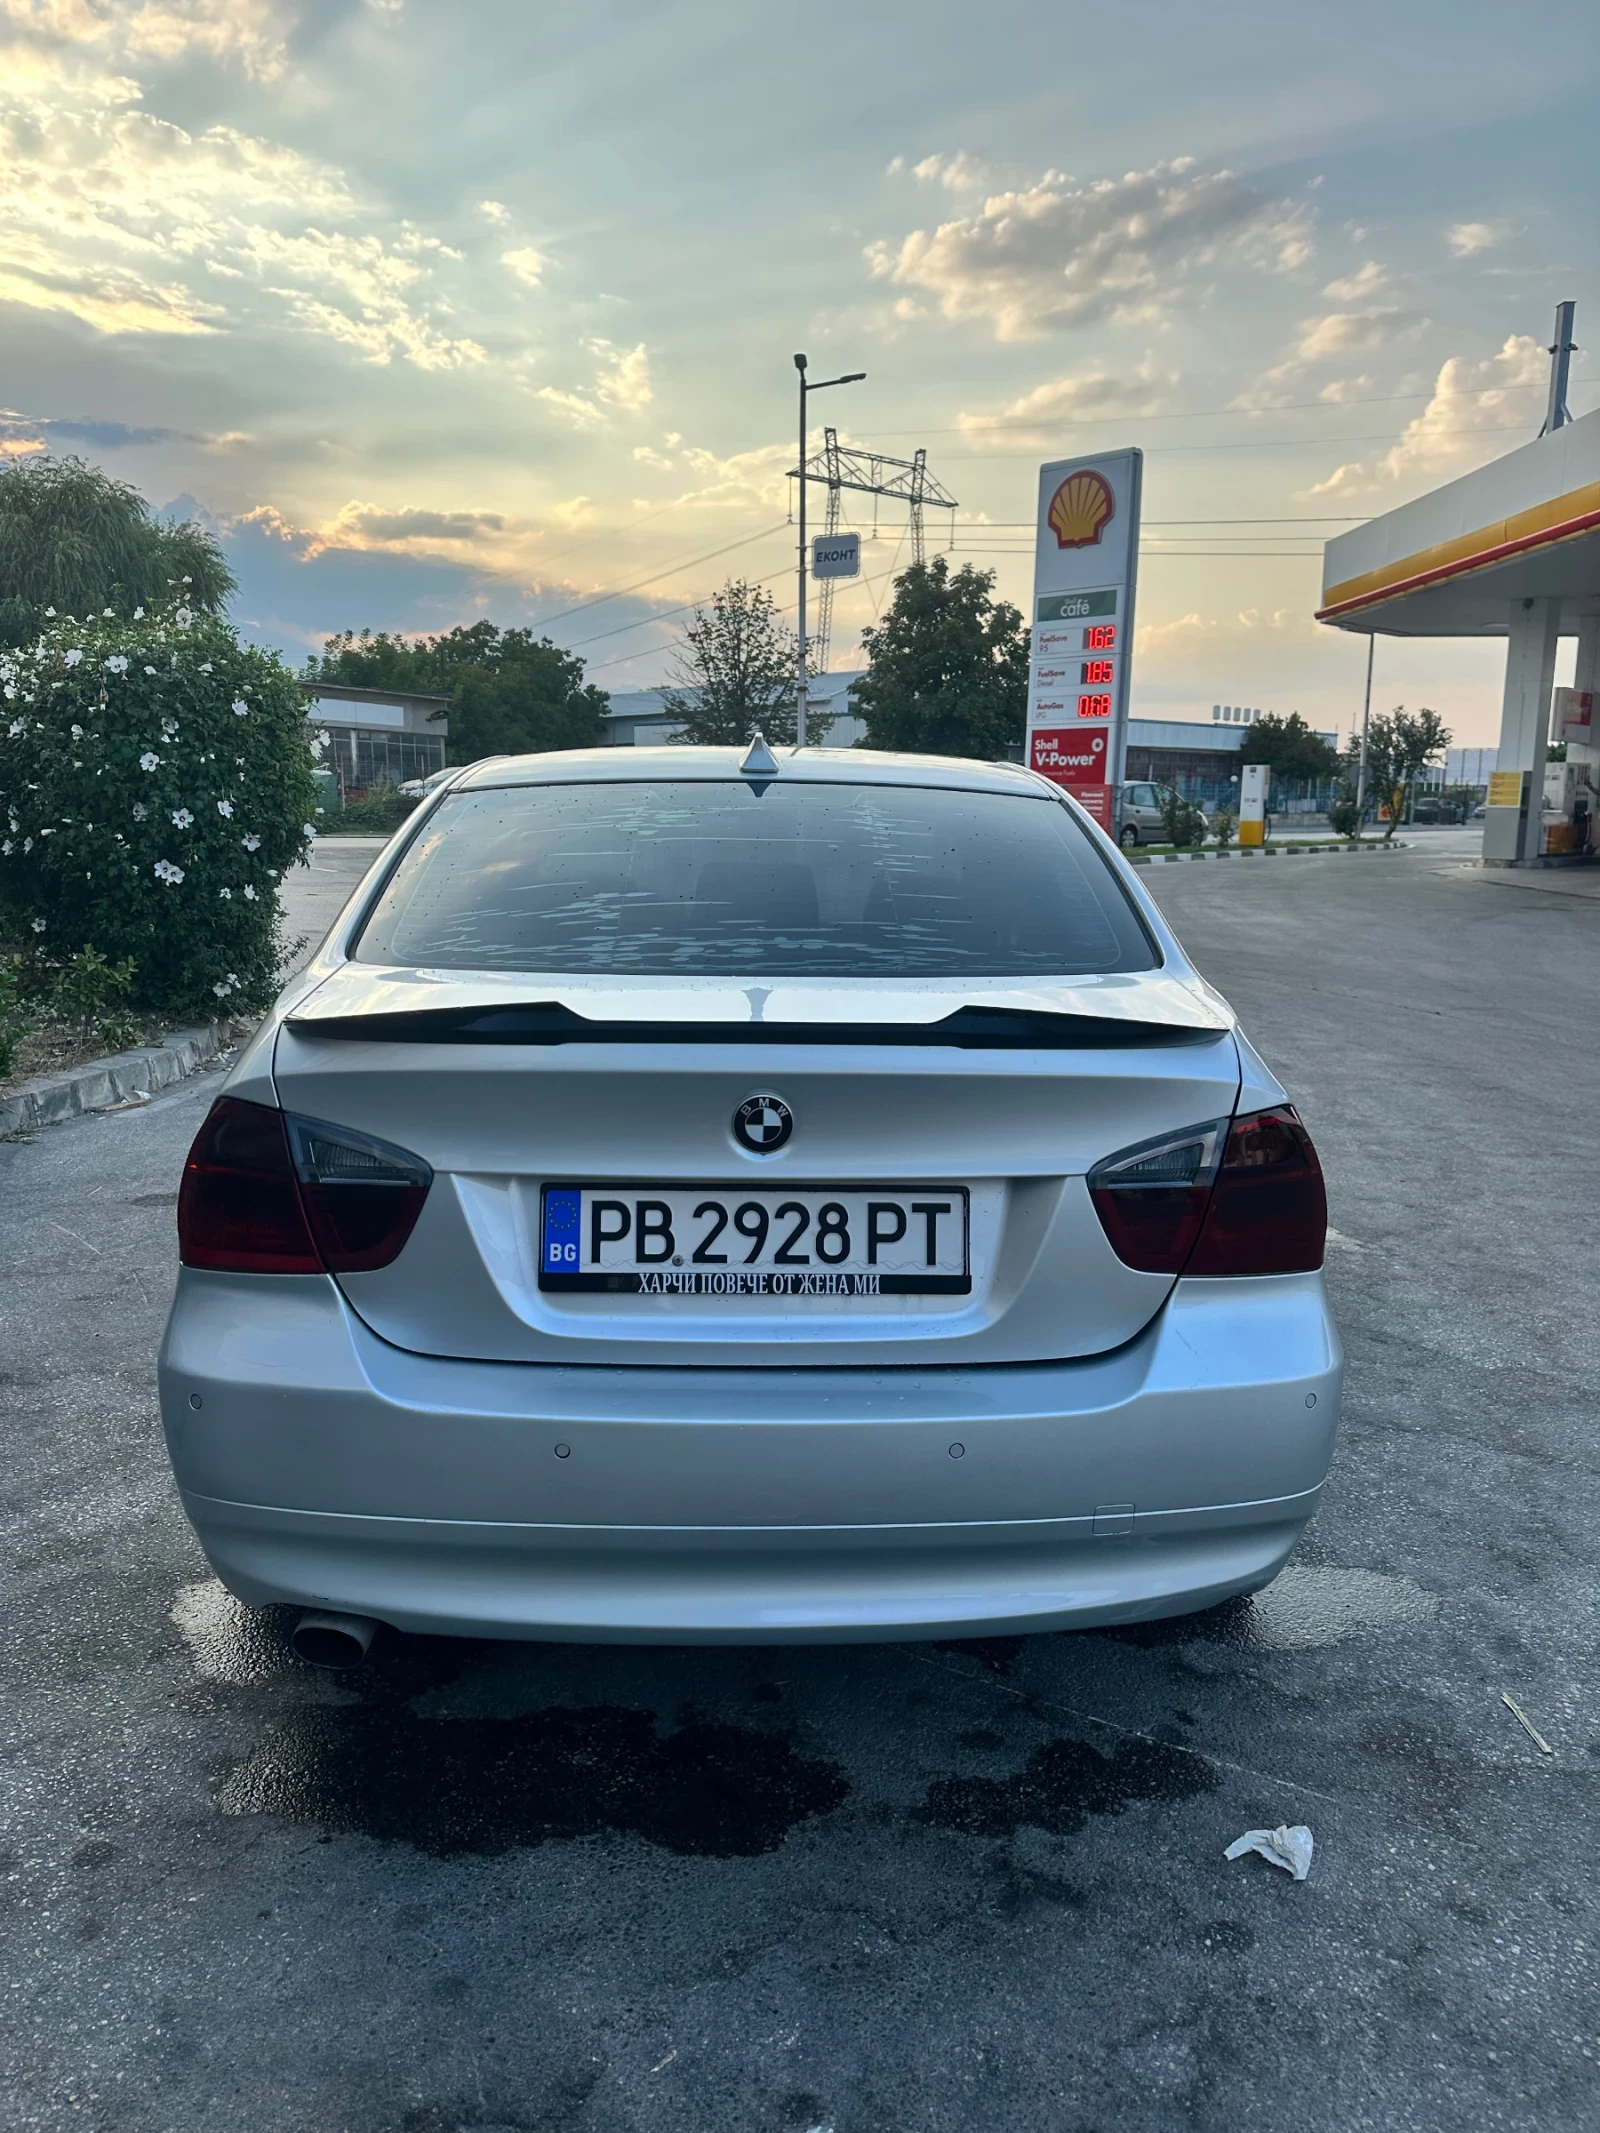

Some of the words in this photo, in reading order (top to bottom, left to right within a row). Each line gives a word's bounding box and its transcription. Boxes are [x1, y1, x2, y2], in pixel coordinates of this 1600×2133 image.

[816, 549, 856, 563] ЕКОНТ
[1060, 599, 1090, 617] café
[1036, 702, 1064, 710] AutoGas
[1034, 739, 1058, 751] Shell
[1035, 752, 1095, 766] V-Power
[740, 1098, 789, 1117] BMW
[591, 1200, 676, 1264] PB
[692, 1201, 850, 1264] 2928
[867, 1202, 951, 1266] PT
[549, 1243, 577, 1262] BG
[638, 1273, 696, 1294] ХАРЧИ
[701, 1273, 767, 1294] ПОВЕЧЕ
[772, 1274, 795, 1294] ОТ
[798, 1274, 849, 1294] ЖЕНА
[854, 1274, 881, 1294] МИ
